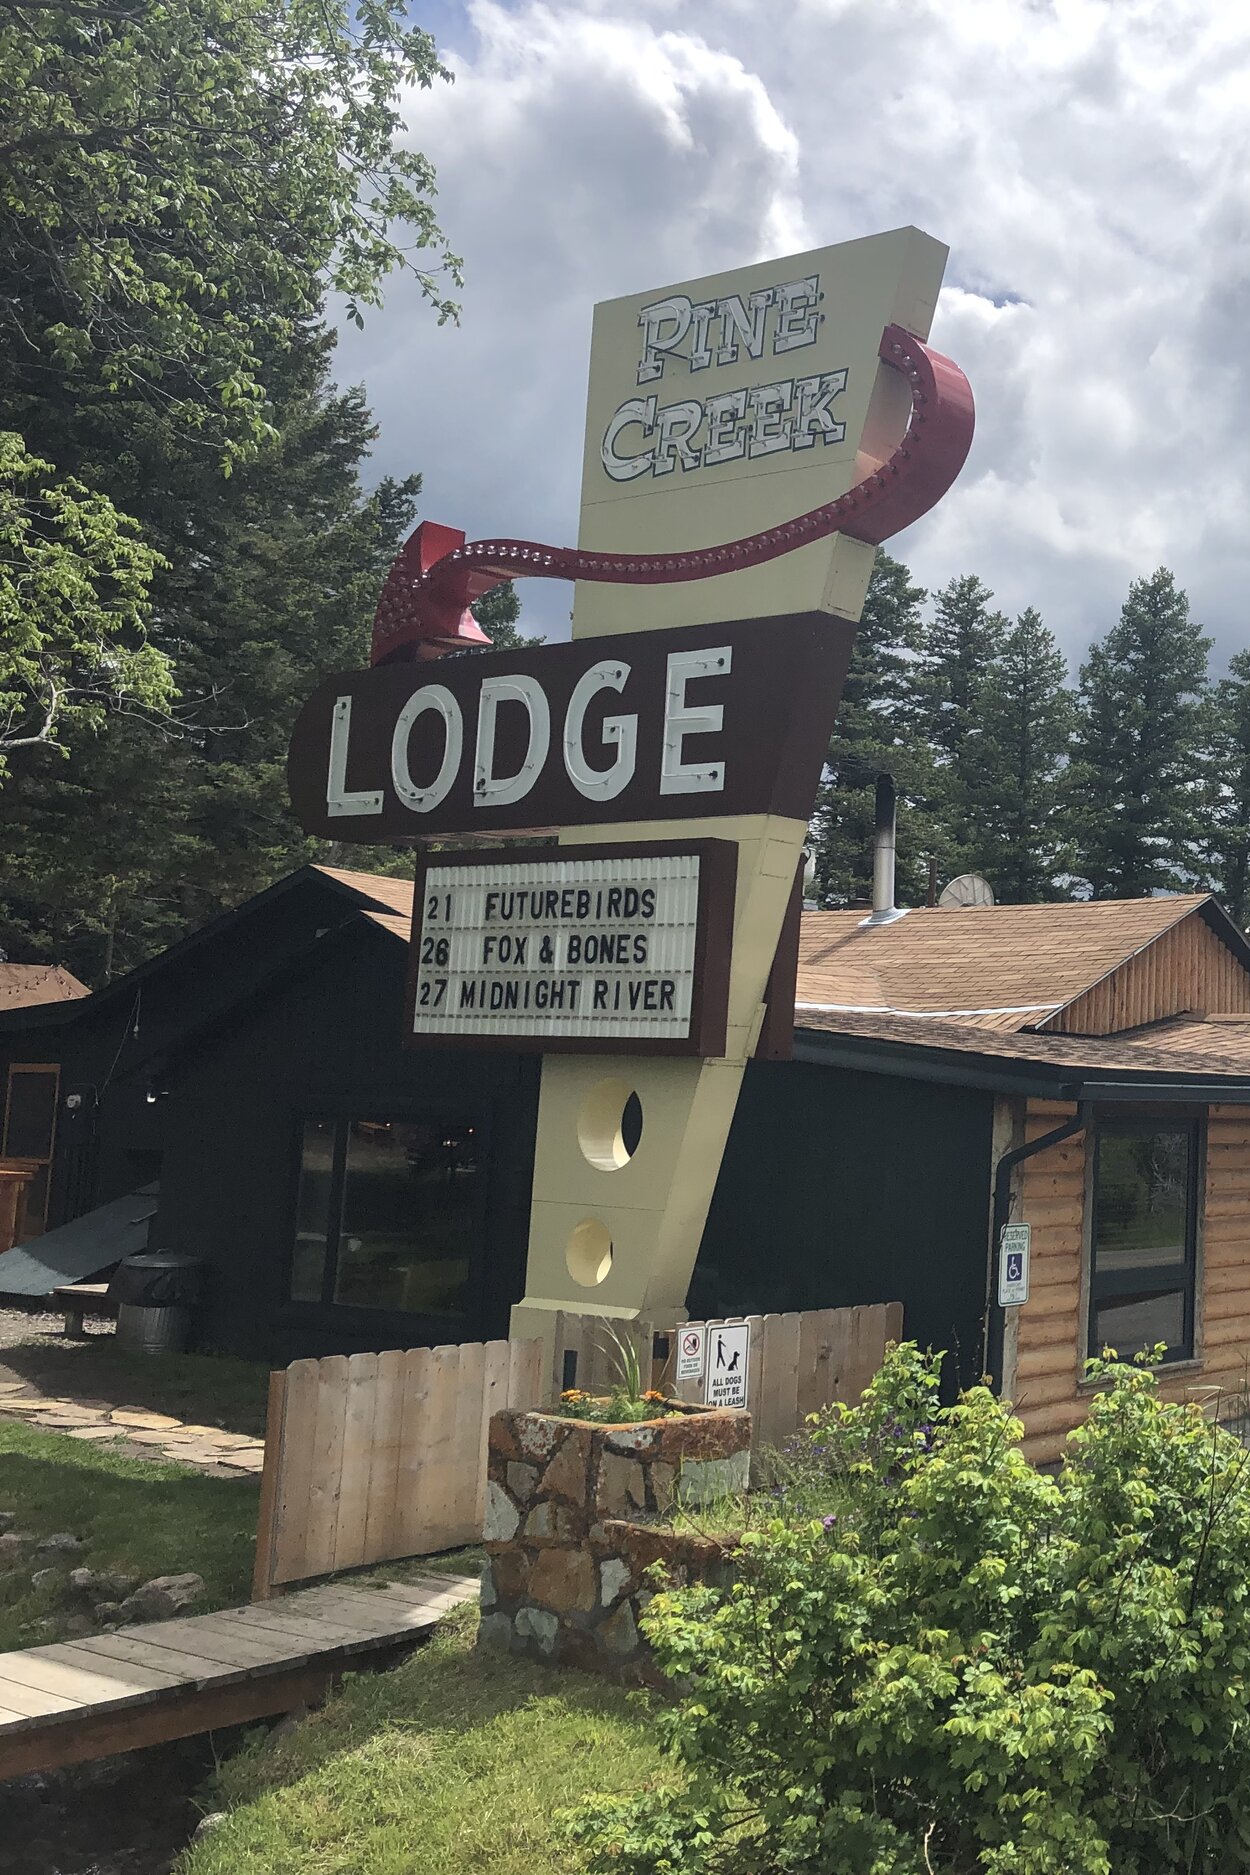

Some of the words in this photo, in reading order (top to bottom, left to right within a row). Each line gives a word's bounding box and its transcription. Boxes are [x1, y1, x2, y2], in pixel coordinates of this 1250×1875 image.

[636, 274, 822, 386] PINE
[601, 368, 849, 482] CREEK
[327, 646, 733, 818] LODGE
[428, 894, 451, 922] 21
[485, 888, 656, 921] FUTUREBIRDS
[421, 937, 450, 966] 26
[483, 935, 528, 965] FOX
[539, 935, 553, 964] &
[567, 934, 648, 964] BONES
[420, 979, 448, 1007] 27
[459, 980, 581, 1010] MIDNIGHT
[593, 980, 676, 1010] RIVER
[1005, 1242, 1026, 1251] PARKING
[712, 1378, 723, 1387] ALL
[725, 1375, 742, 1385] DOGS
[713, 1387, 731, 1397] MUST
[731, 1386, 740, 1395] BE
[718, 1398, 723, 1407] A
[724, 1397, 744, 1406] LEASH
